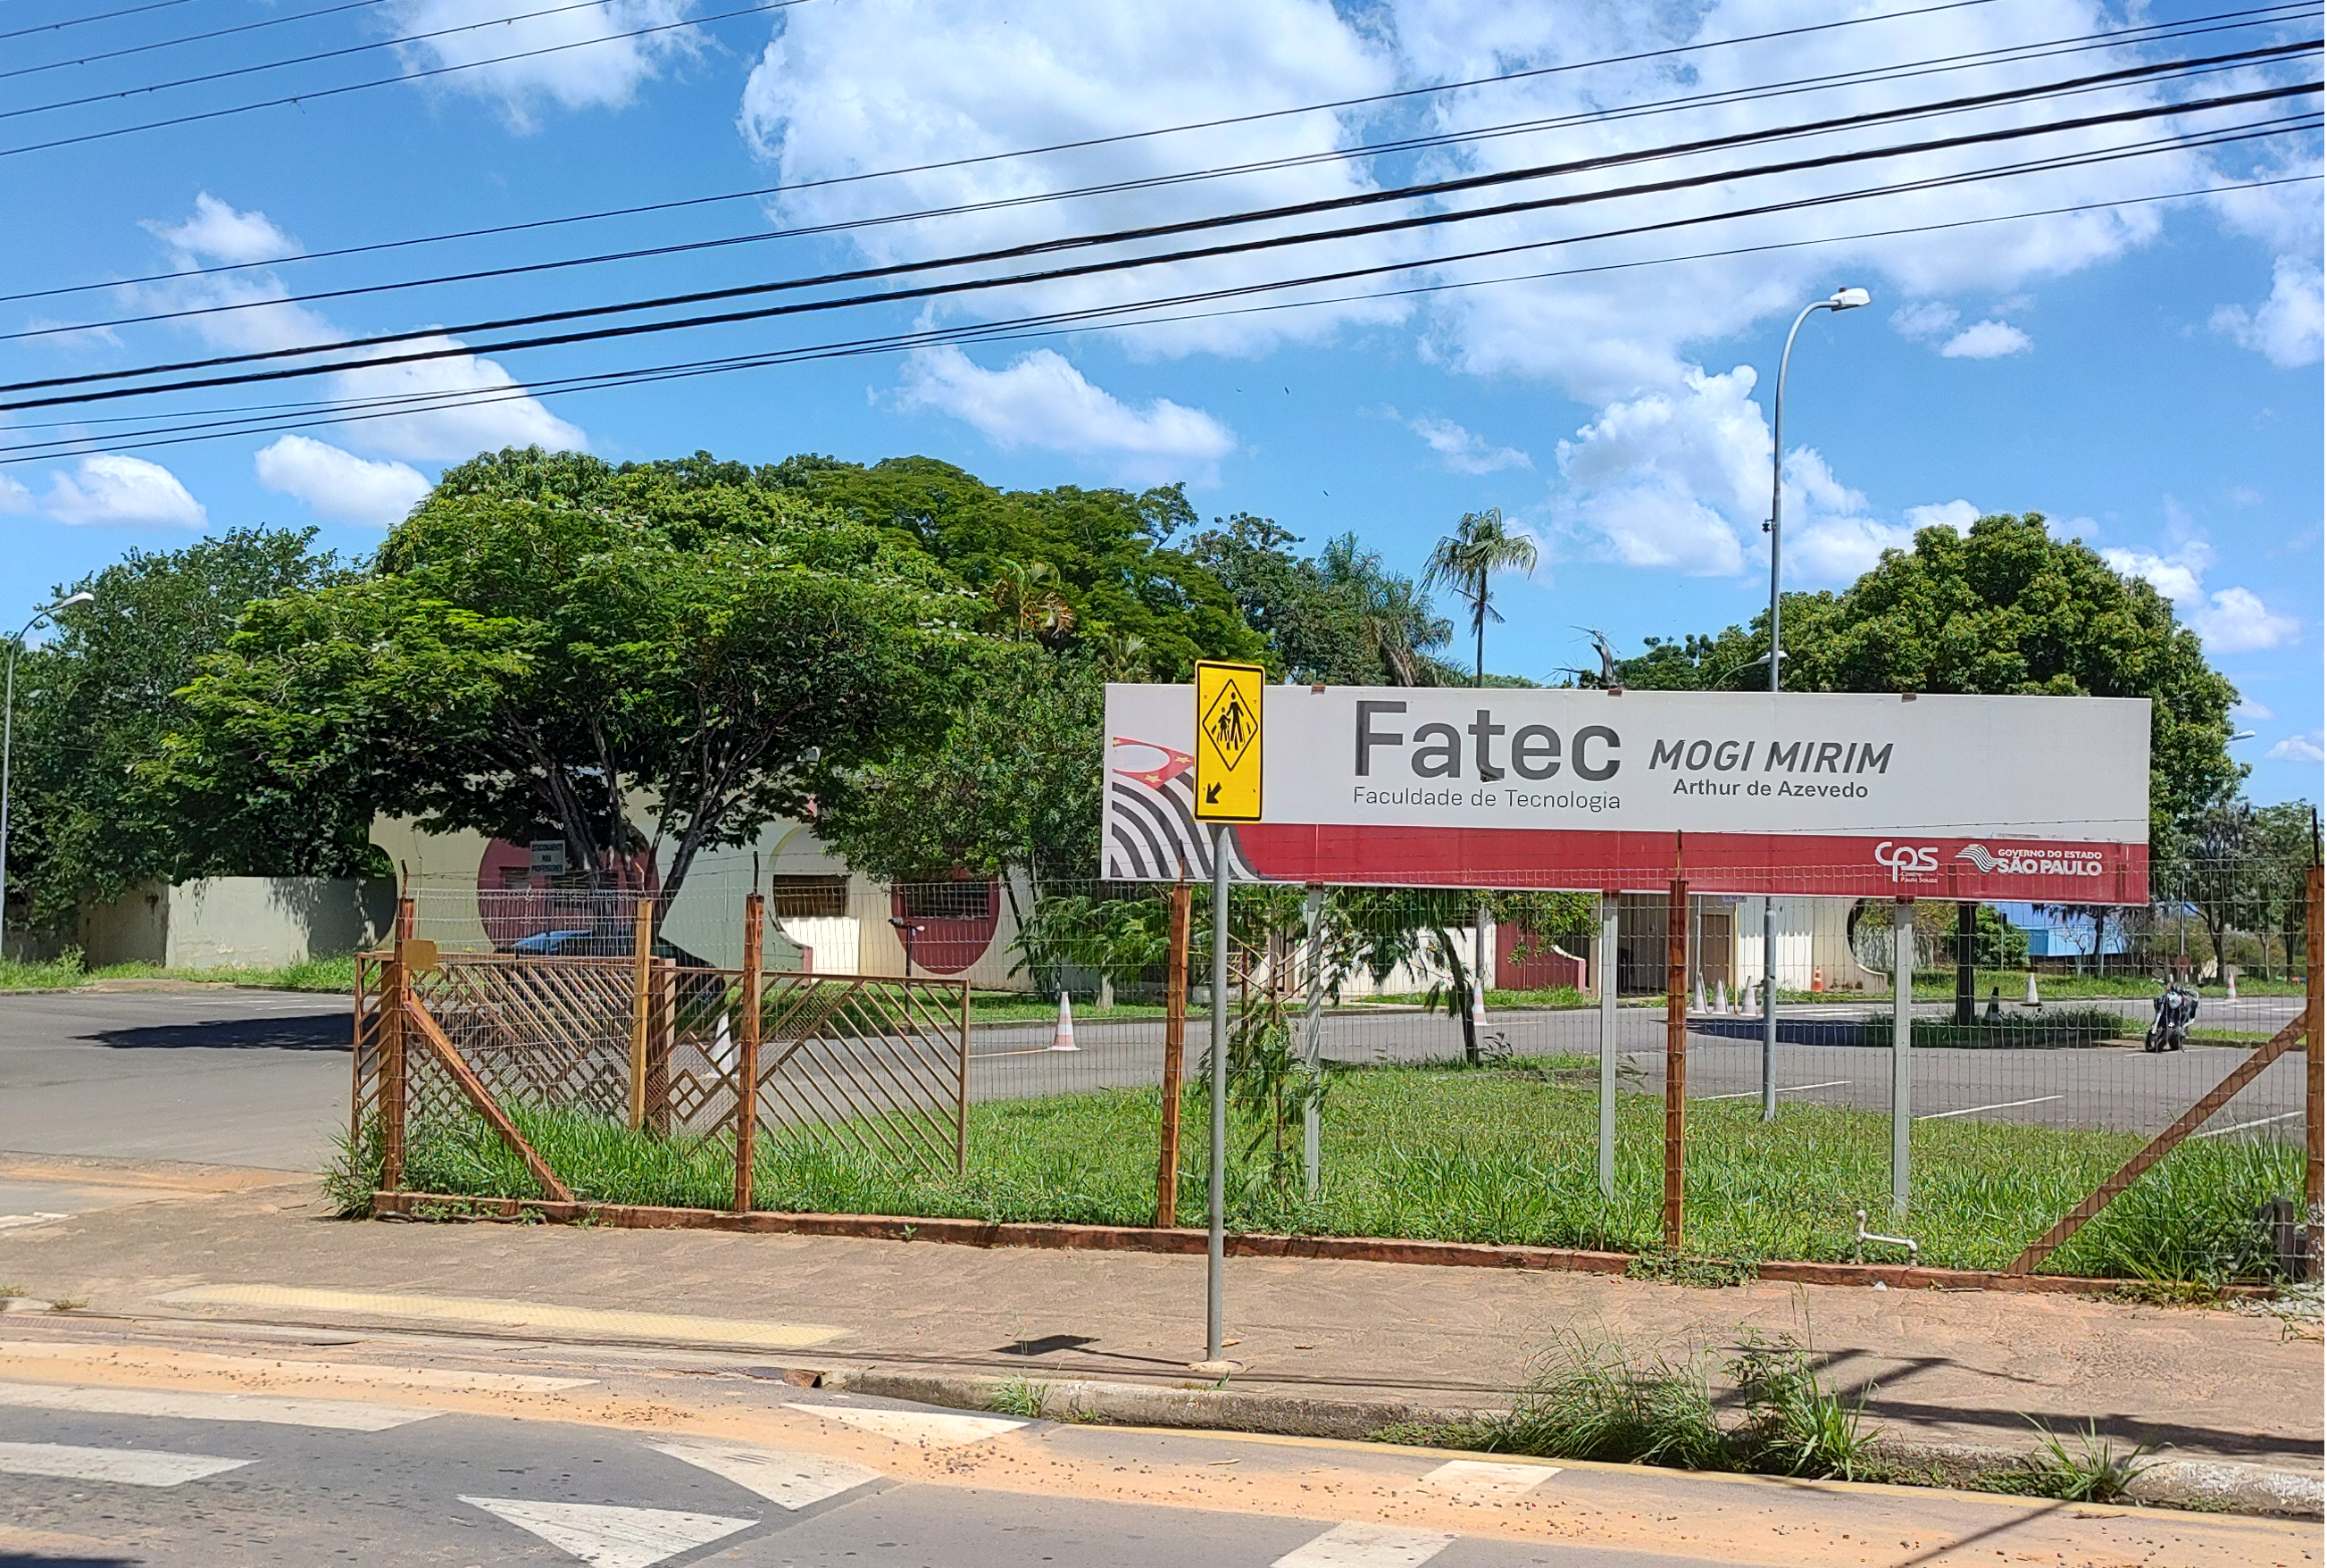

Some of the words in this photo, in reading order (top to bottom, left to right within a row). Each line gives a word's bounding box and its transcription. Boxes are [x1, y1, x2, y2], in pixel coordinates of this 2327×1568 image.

[1355, 700, 1621, 782] Fatec
[1648, 738, 1756, 771] MOGI
[1764, 741, 1894, 774] MIRIM
[1354, 786, 1463, 806] Faculdade
[1471, 788, 1497, 807] de
[1504, 789, 1620, 813] Tecnologia
[1672, 778, 1741, 796] Arthur
[1747, 780, 1772, 797] de
[1777, 780, 1868, 798] Azevedo
[1997, 855, 2039, 874] SÃO
[2039, 859, 2103, 877] PAULO
[1998, 848, 2045, 858] GOVERNO
[2047, 849, 2063, 858] DO
[2064, 850, 2103, 860] ESTADO
